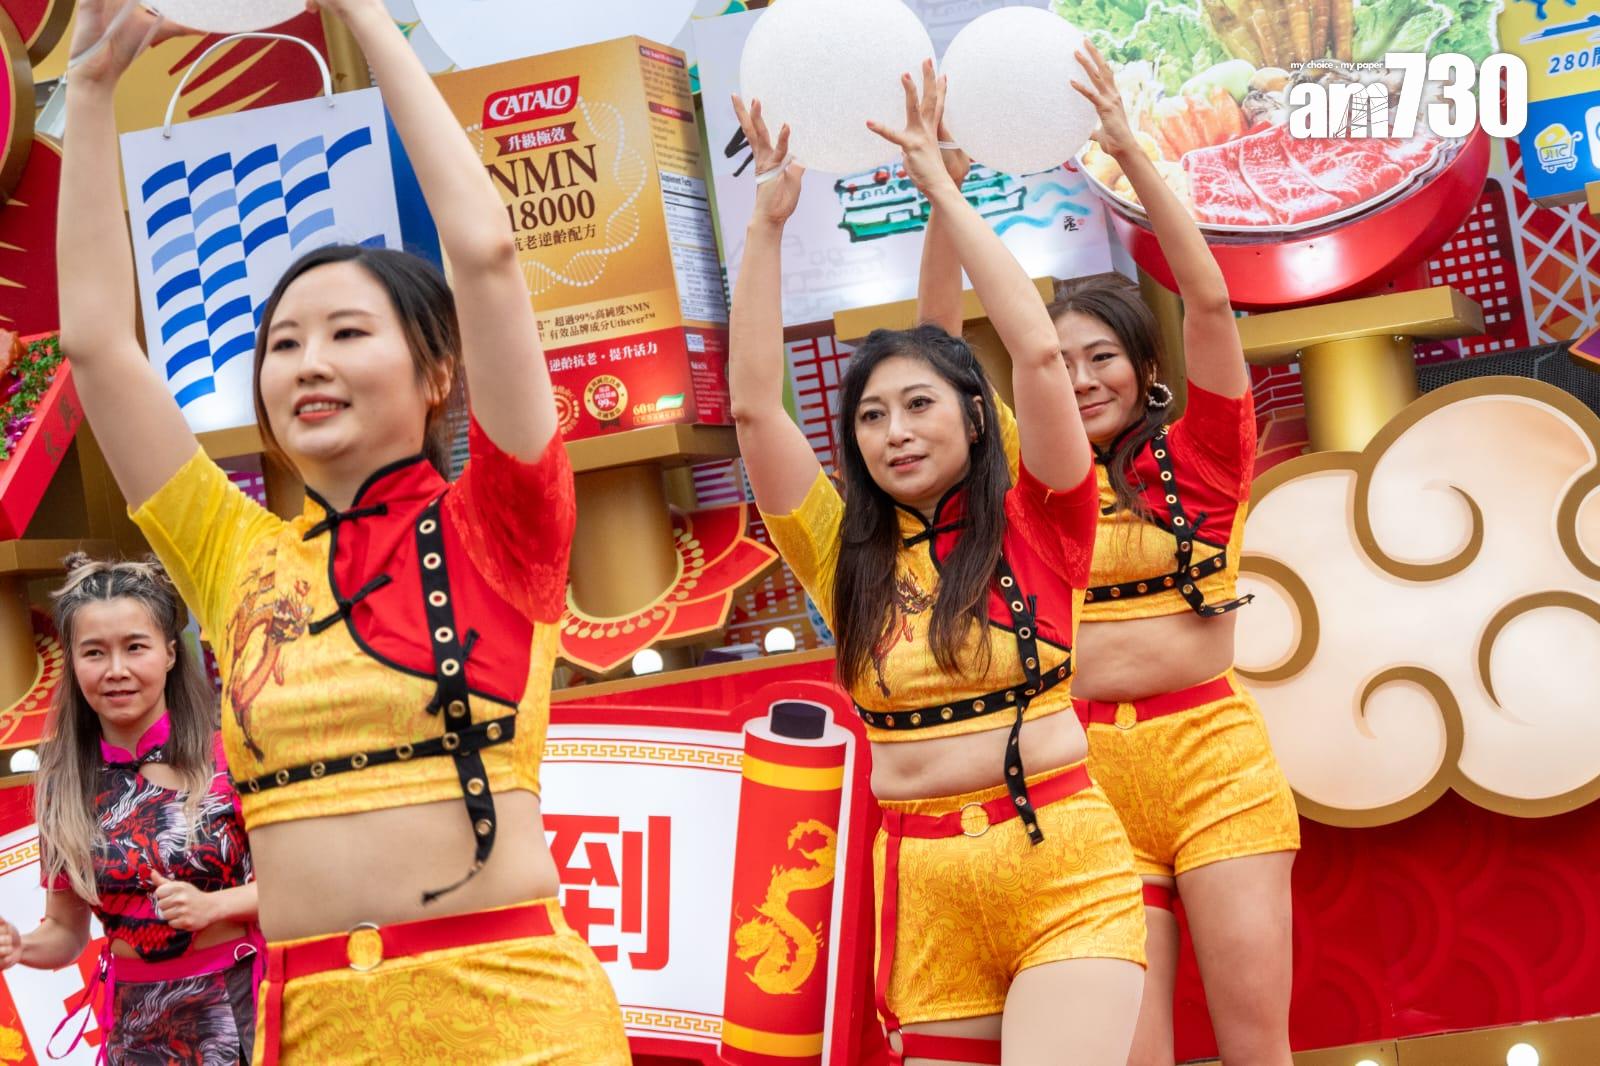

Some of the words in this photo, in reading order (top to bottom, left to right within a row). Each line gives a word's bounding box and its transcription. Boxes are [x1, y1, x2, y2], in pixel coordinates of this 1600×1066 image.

[488, 85, 572, 121] CATALO
[507, 127, 567, 152] 升級極效
[484, 143, 598, 198] NMN
[506, 189, 595, 233] 18000
[542, 813, 672, 971] 到
